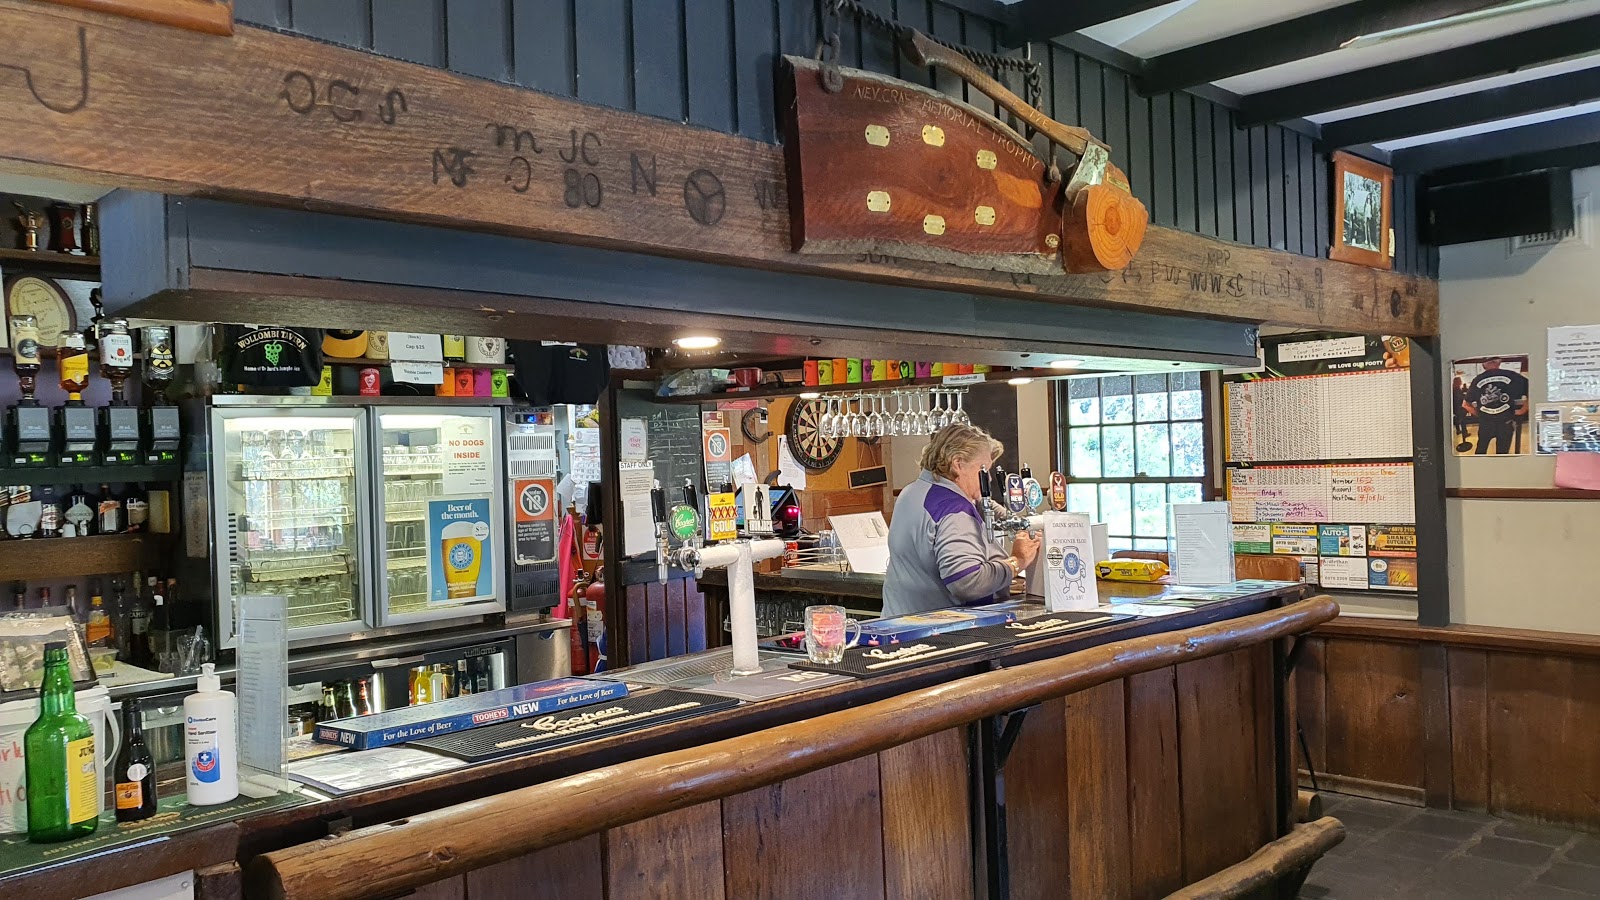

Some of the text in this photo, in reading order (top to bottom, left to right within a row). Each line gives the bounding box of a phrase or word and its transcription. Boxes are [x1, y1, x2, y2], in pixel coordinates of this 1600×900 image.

[991, 126, 1041, 171] TROPHY
[237, 330, 307, 351] WOLLOMBI TAVERN
[462, 439, 485, 447] DOGS
[447, 502, 472, 512] Beer of
[710, 506, 738, 519] XXXX
[441, 512, 453, 520] the
[713, 519, 736, 533] GOLD
[556, 688, 614, 706] For the Love of Beer
[474, 702, 540, 723] TOOHEYS NEW
[521, 705, 630, 731] Coopers
[339, 732, 356, 745] NEW
[383, 721, 453, 741] For the Love of Beer
[185, 806, 237, 821] PREMIUM
